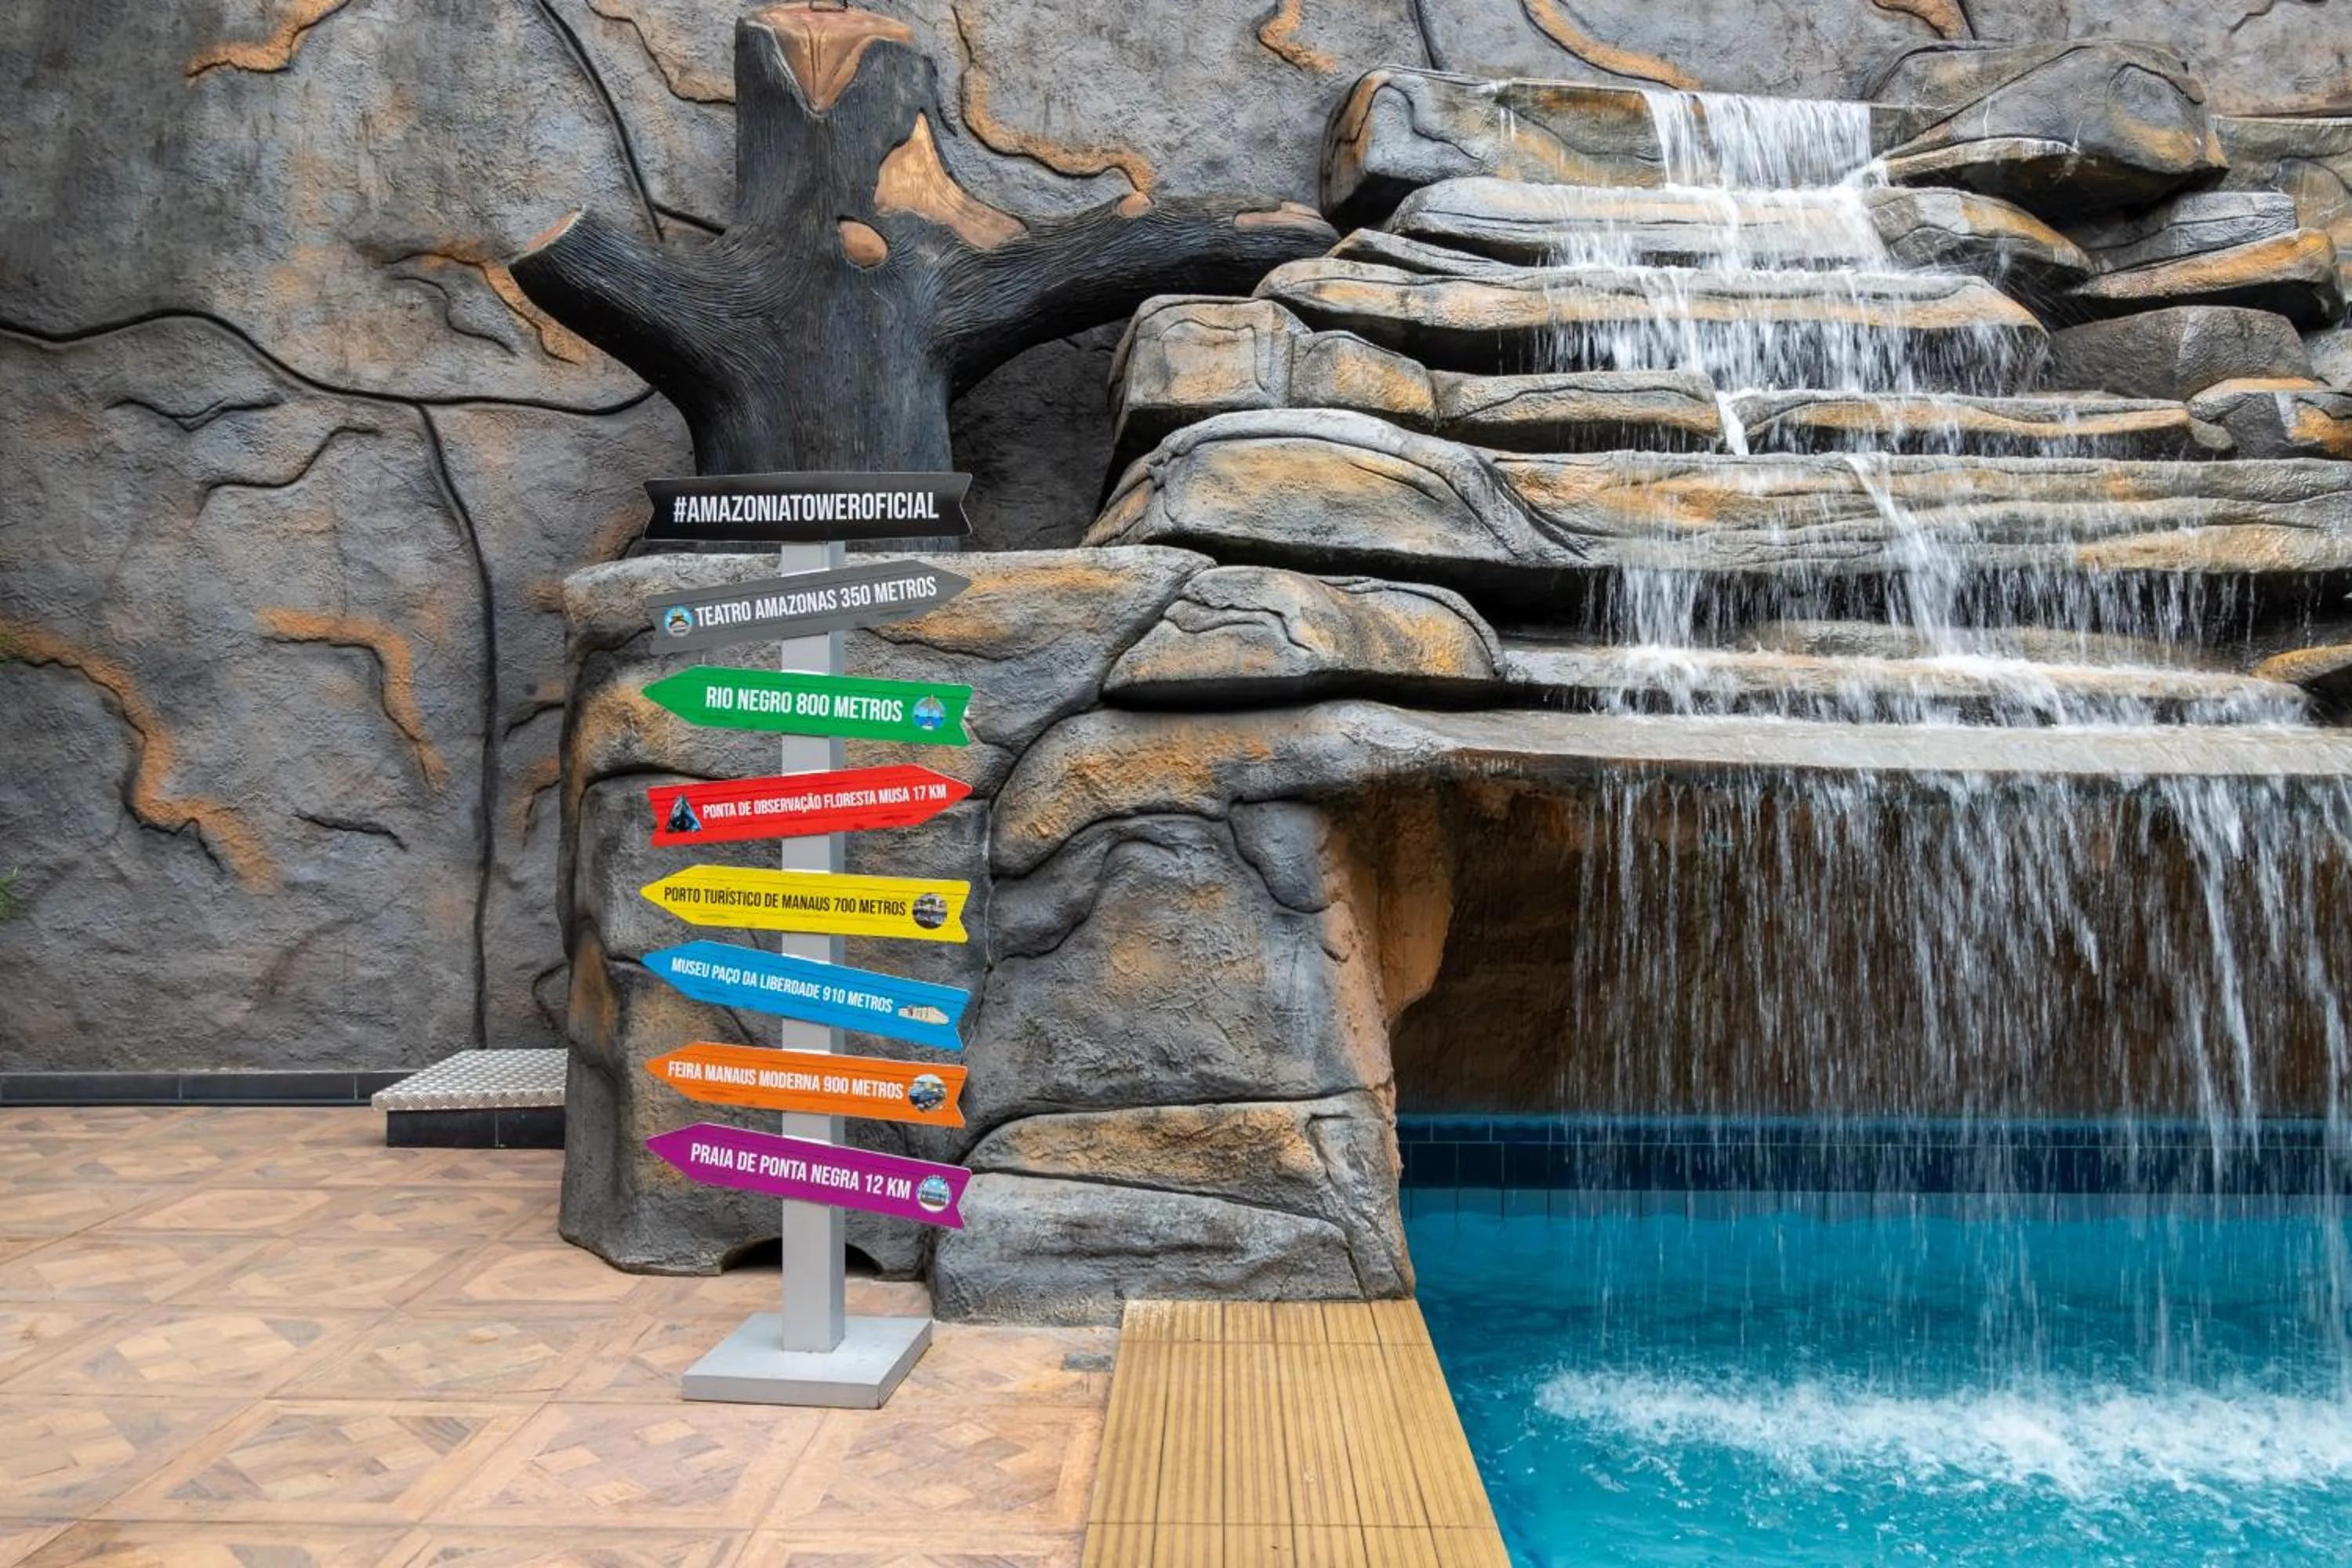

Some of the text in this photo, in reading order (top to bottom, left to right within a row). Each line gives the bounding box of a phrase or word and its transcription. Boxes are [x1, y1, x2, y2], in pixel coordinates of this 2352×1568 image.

[673, 492, 939, 523] #AMAZONIATOWEROFICIAL
[695, 576, 937, 627] TEATRO AMAZONAS 350 METROS
[706, 686, 903, 722] RIO NEGRO 800 METROS
[702, 784, 946, 819] PONTA DE OBSERVAÇÃO FLORESTA MUSA 17 KM
[664, 887, 906, 916] PORTO TURÍSTICO DE MANAUS 700 METROS
[671, 957, 893, 1013] MUSEU PAÇO DA LIBERDADE 910 METROS
[668, 1061, 903, 1100] FEIRA MANAUS MODERNA 900 METROS
[691, 1143, 911, 1200] PRAIA DE PONTA NEGRA 12 KM
